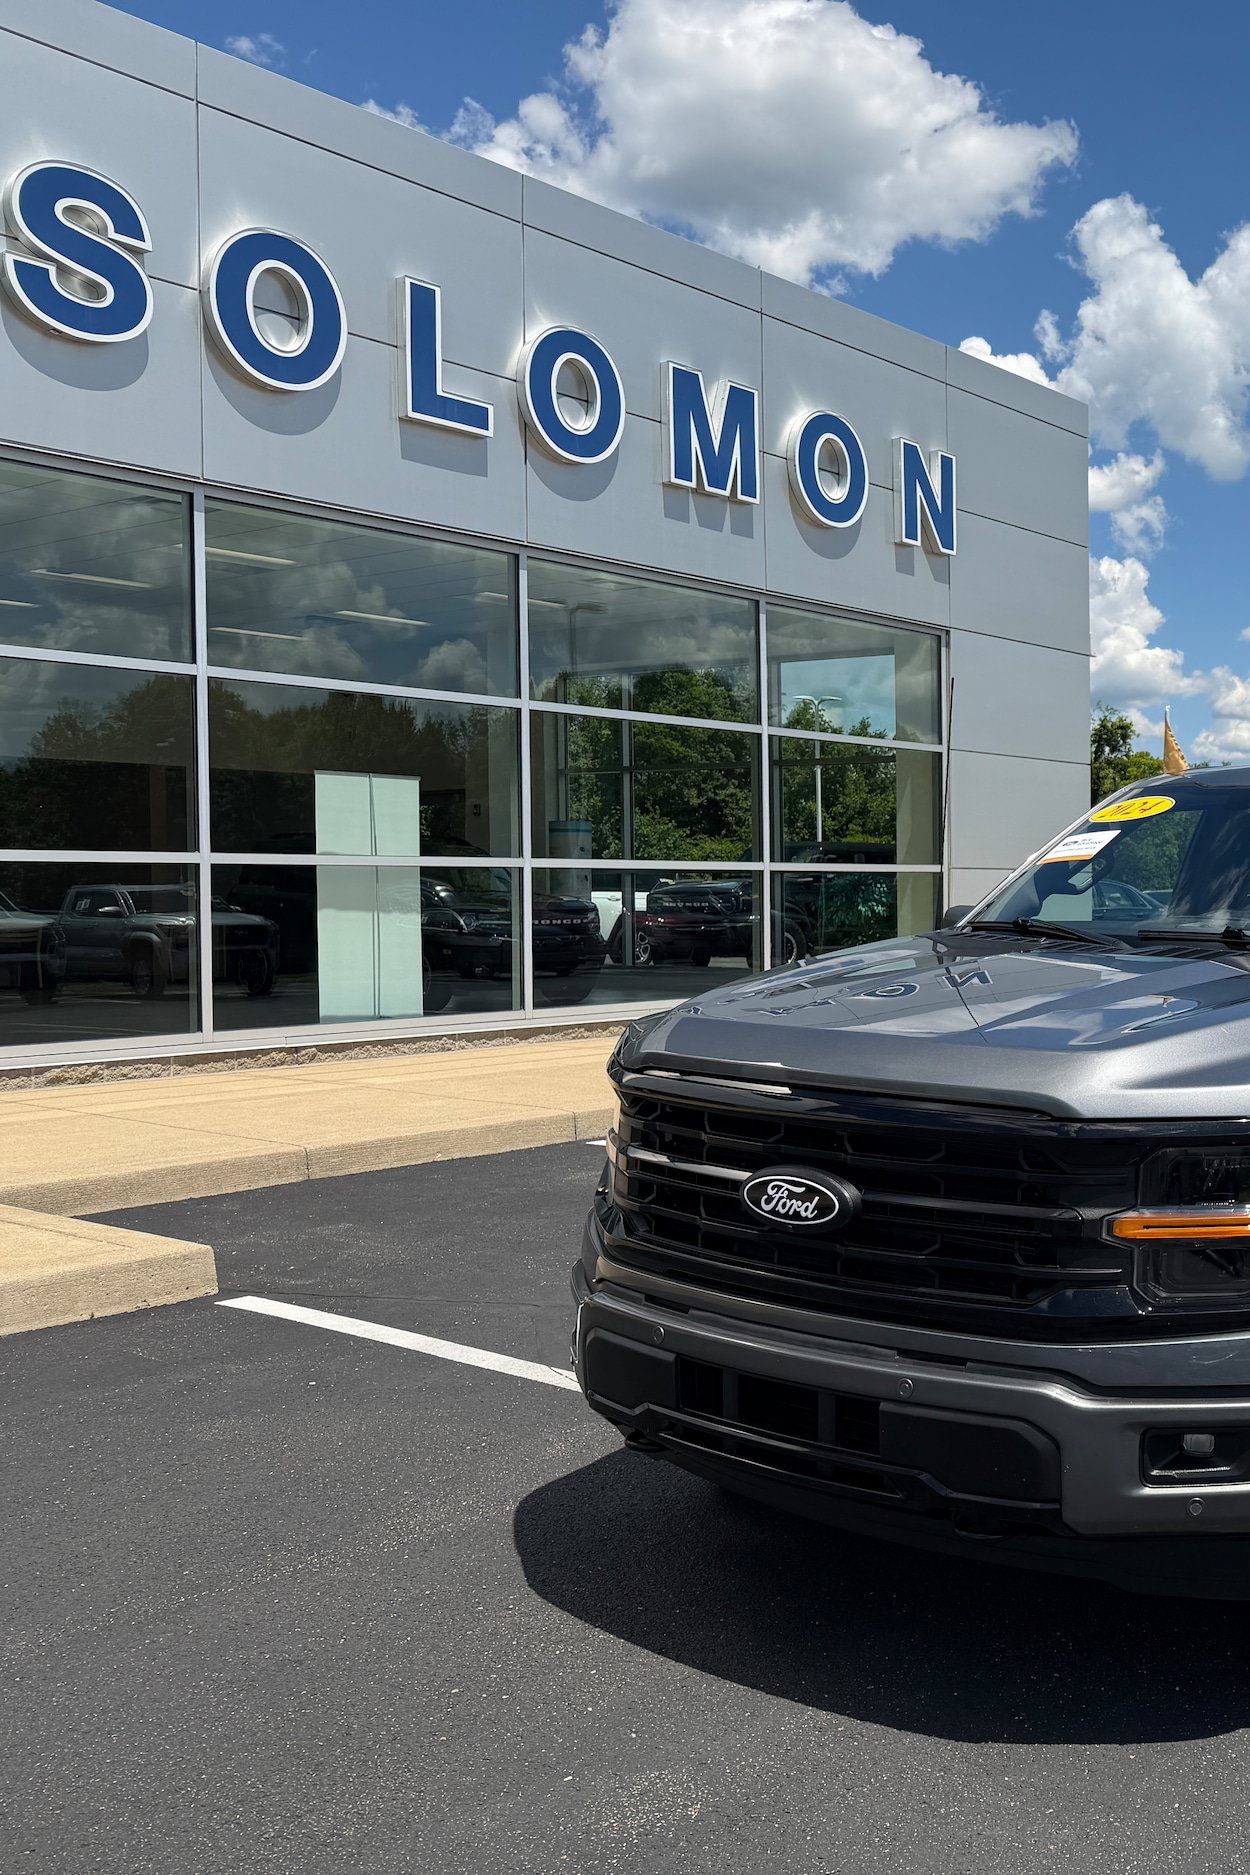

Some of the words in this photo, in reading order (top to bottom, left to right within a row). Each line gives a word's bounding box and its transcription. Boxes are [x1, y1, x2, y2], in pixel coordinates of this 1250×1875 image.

[4, 160, 957, 557] SOLOMON
[1096, 799, 1167, 819] 2024
[760, 1181, 820, 1219] Ford
